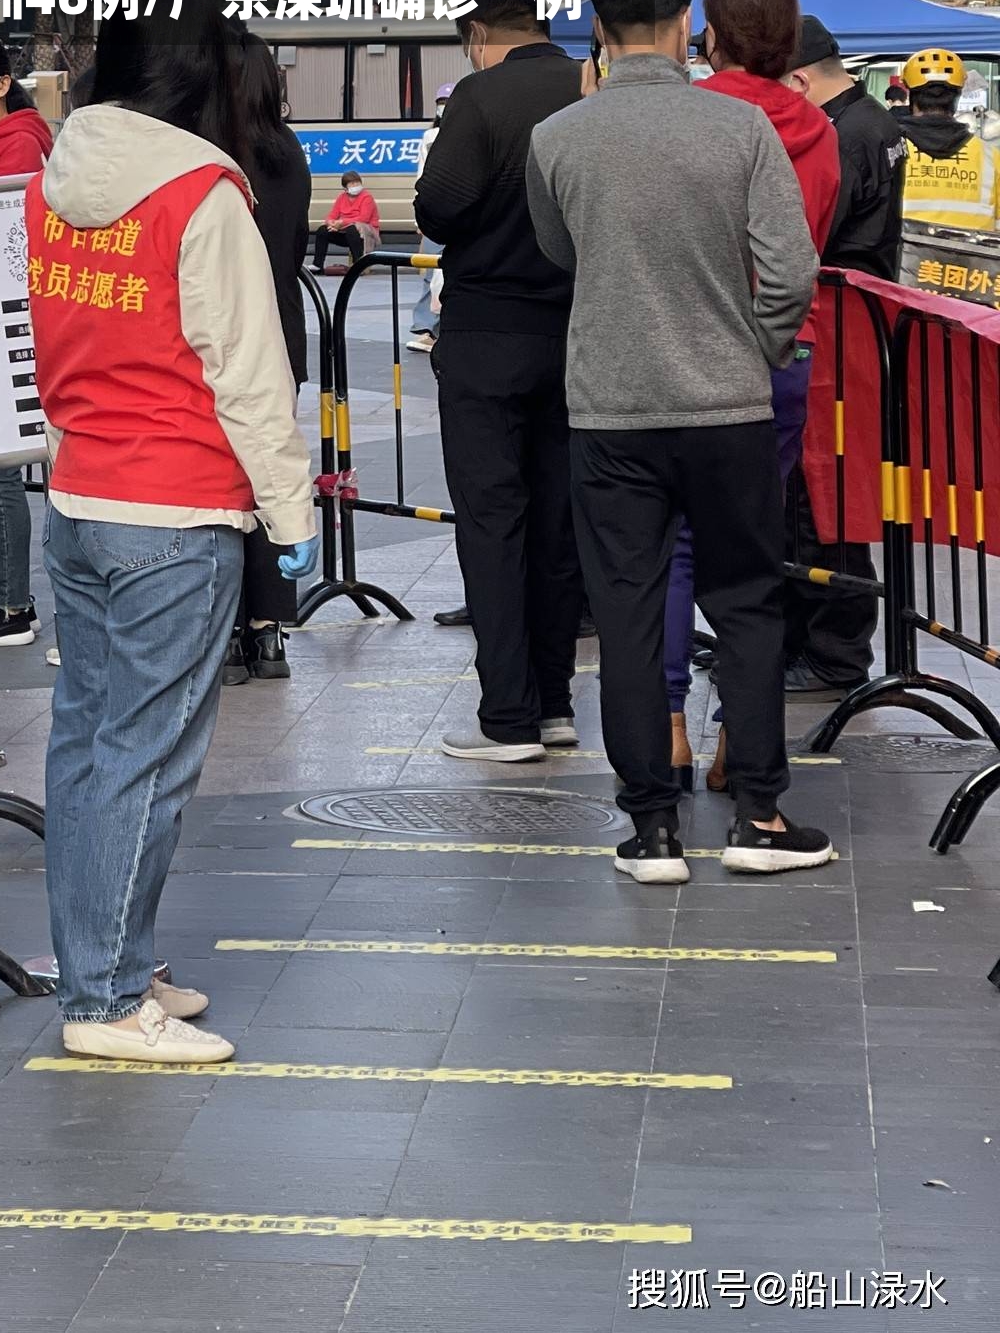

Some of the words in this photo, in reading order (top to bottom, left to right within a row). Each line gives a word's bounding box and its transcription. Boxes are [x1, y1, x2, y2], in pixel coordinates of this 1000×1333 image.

[339, 138, 422, 165] 沃尔玛
[28, 255, 150, 313] 党员志愿者
[174, 1216, 337, 1231] 保持距离
[362, 1222, 617, 1237] 一米线外等候
